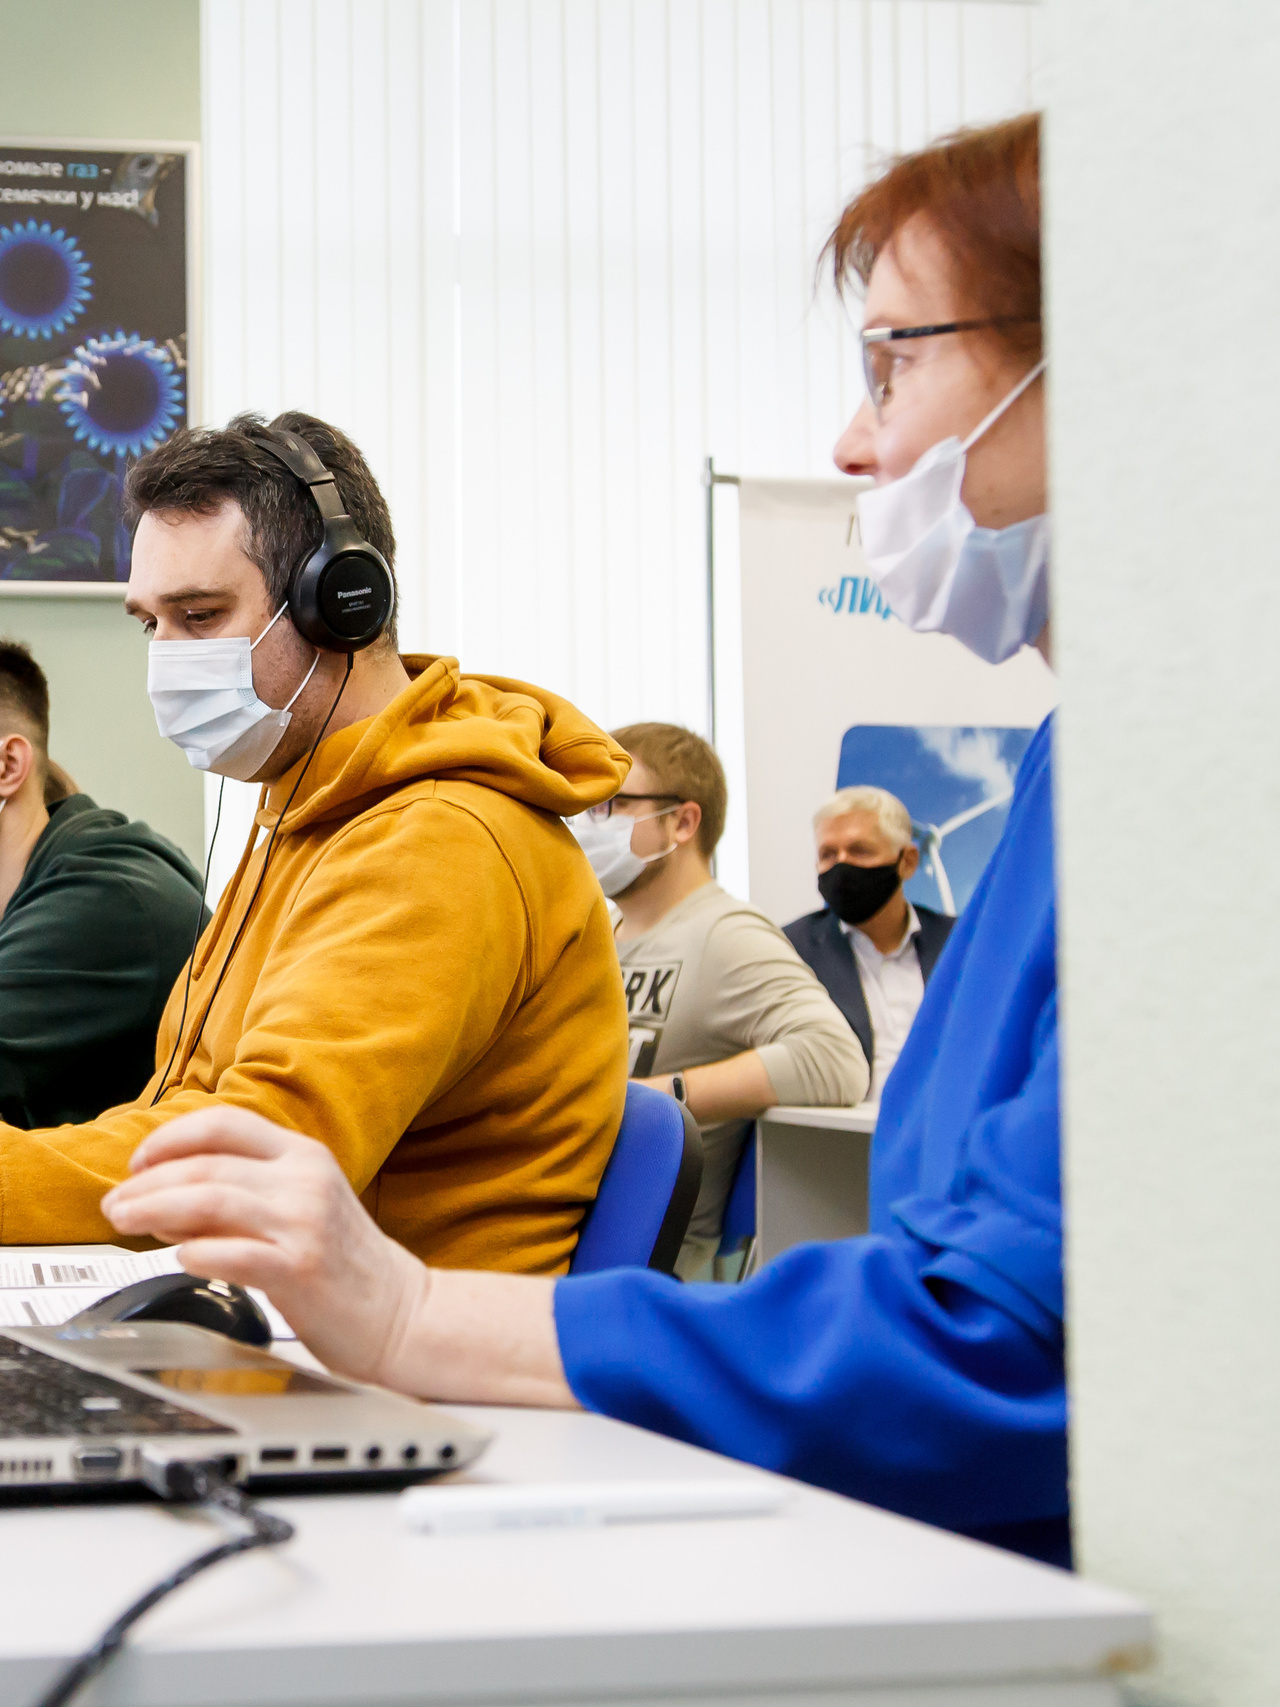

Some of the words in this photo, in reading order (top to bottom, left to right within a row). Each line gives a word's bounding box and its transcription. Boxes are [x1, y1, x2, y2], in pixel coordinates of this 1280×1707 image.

[66, 162, 99, 179] газ
[80, 190, 95, 210] у
[336, 586, 373, 600] Panasonic
[818, 576, 892, 620] «ЛИ
[622, 969, 674, 1015] RK
